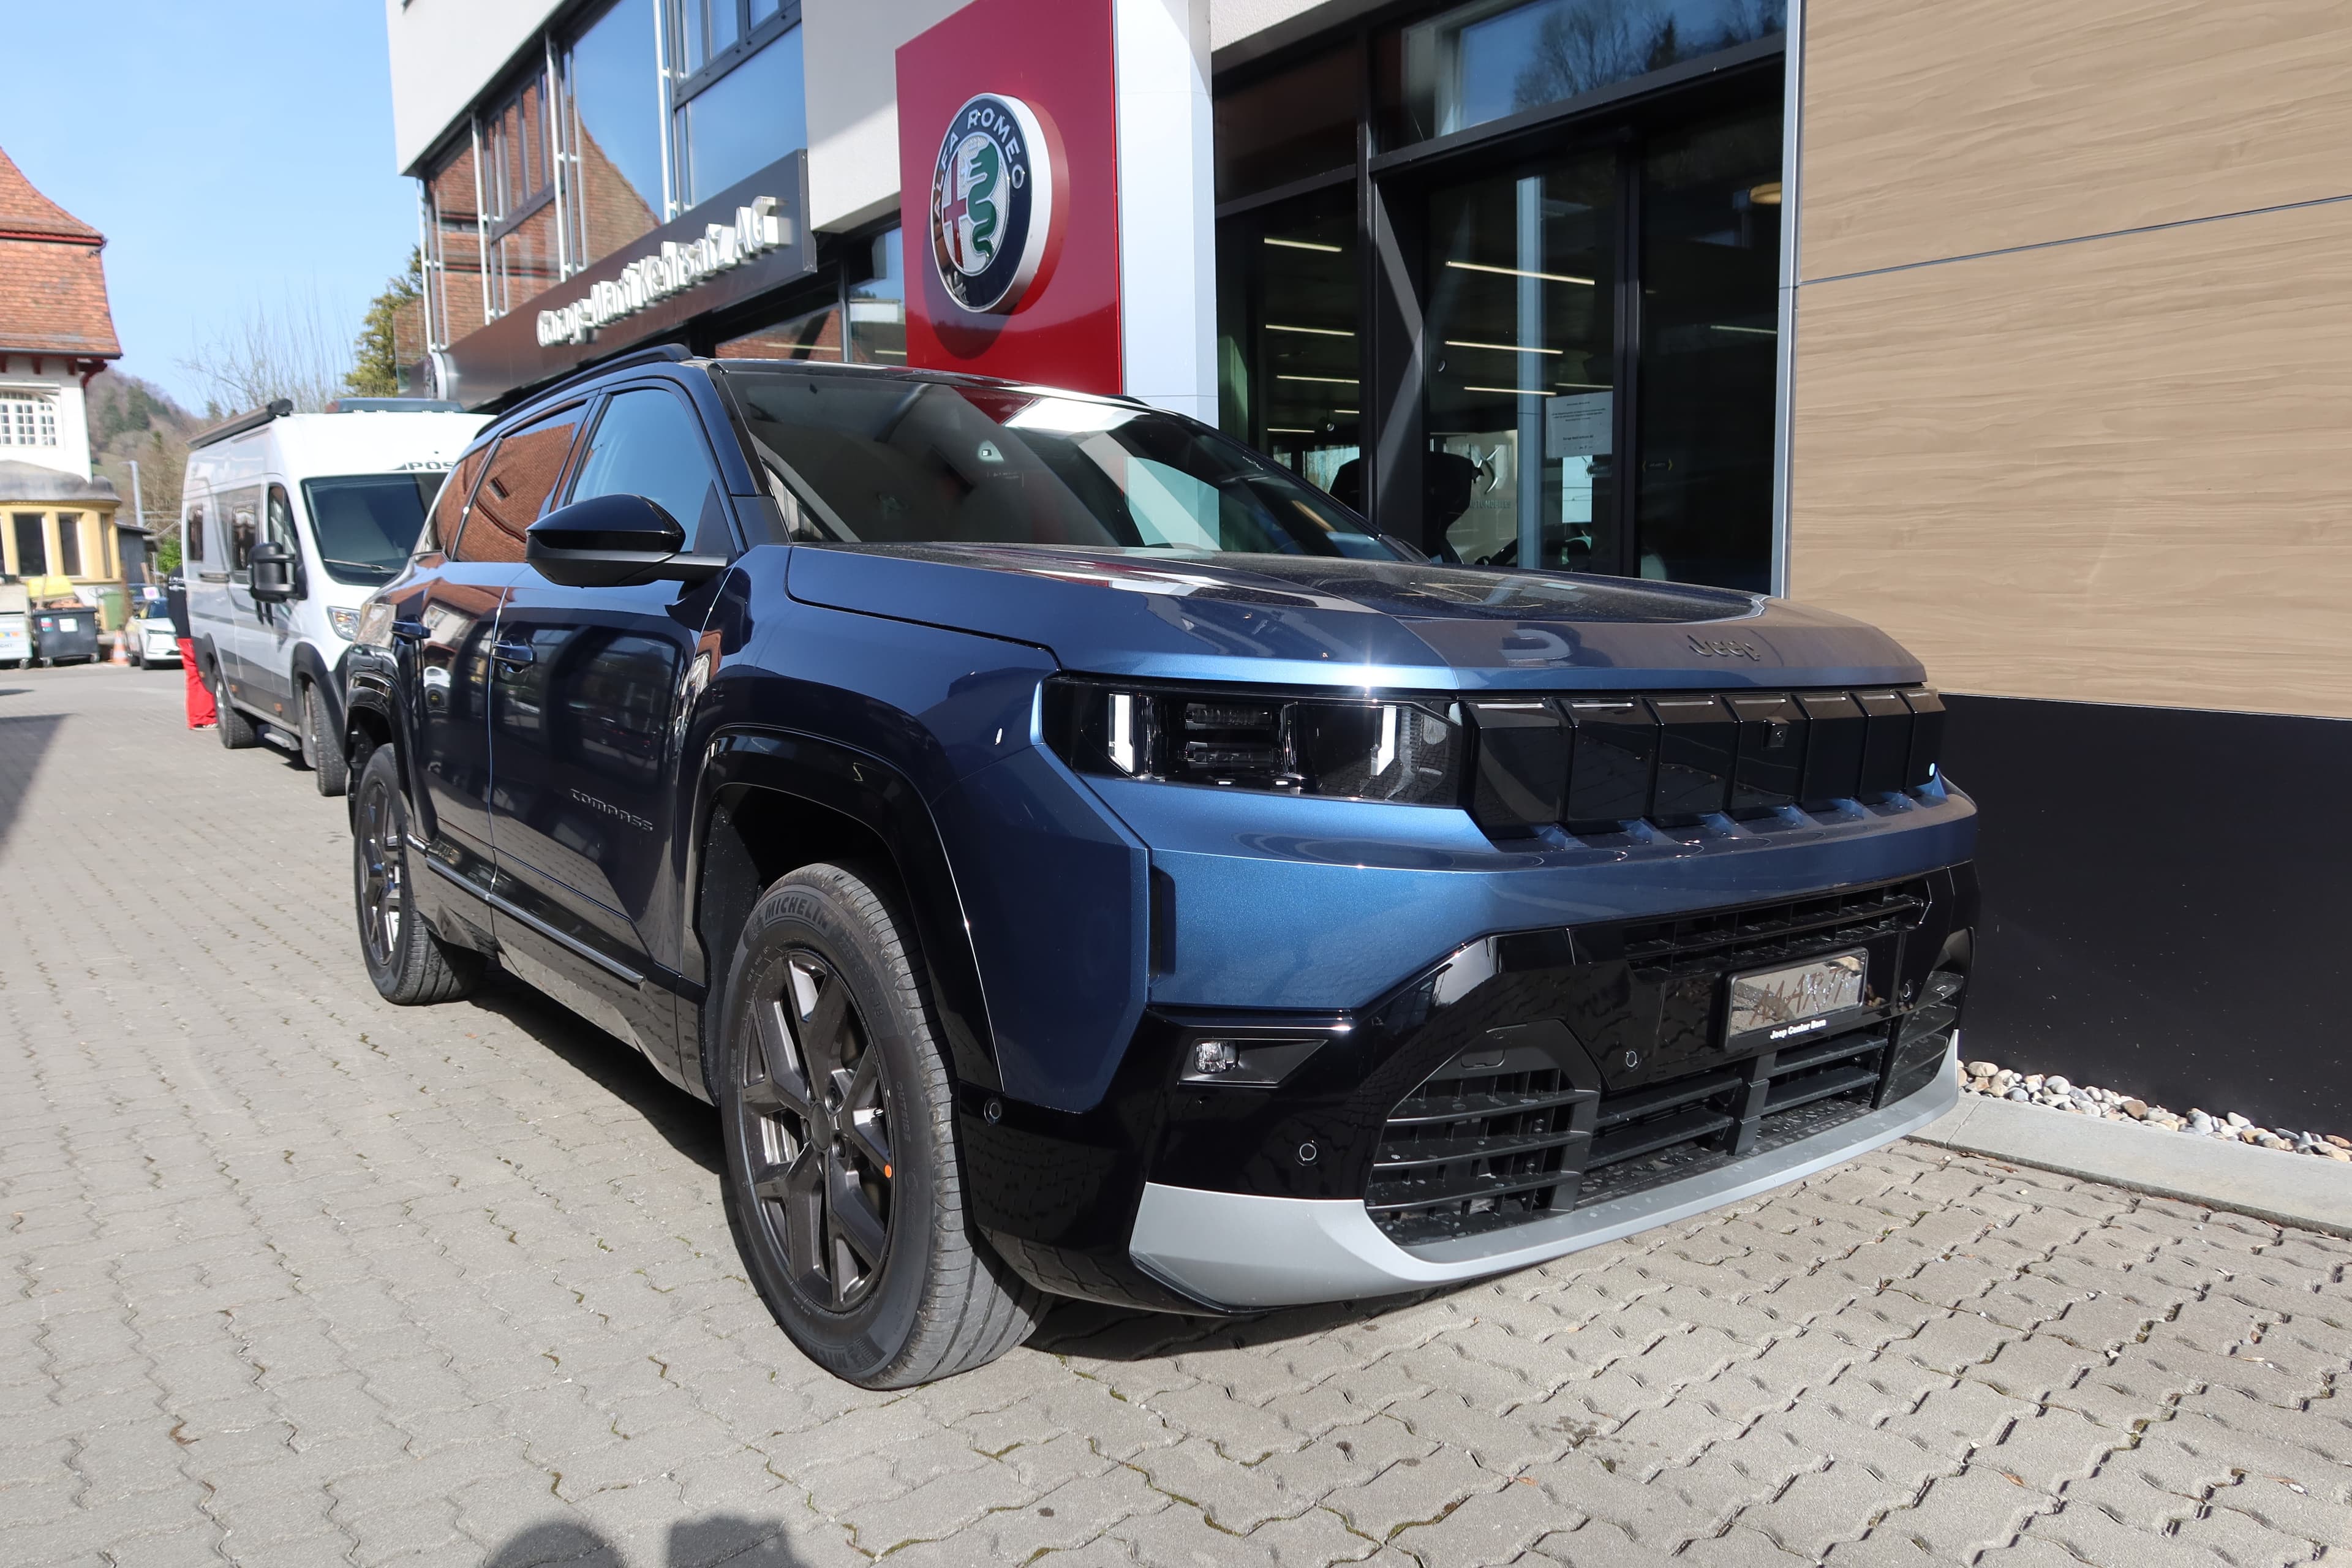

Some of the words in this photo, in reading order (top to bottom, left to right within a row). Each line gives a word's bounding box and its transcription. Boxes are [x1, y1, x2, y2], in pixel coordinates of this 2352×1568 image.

[933, 131, 959, 219] ALFA
[967, 107, 1026, 189] ROMEO
[537, 298, 594, 347] Garage
[733, 195, 779, 258] AG
[1687, 634, 1760, 662] Jeep
[570, 788, 654, 831] COMPASS
[765, 895, 828, 931] MICHELIN
[1770, 1029, 1787, 1039] Jeep
[1787, 1022, 1811, 1035] Center
[1811, 1019, 1826, 1030] Bern
